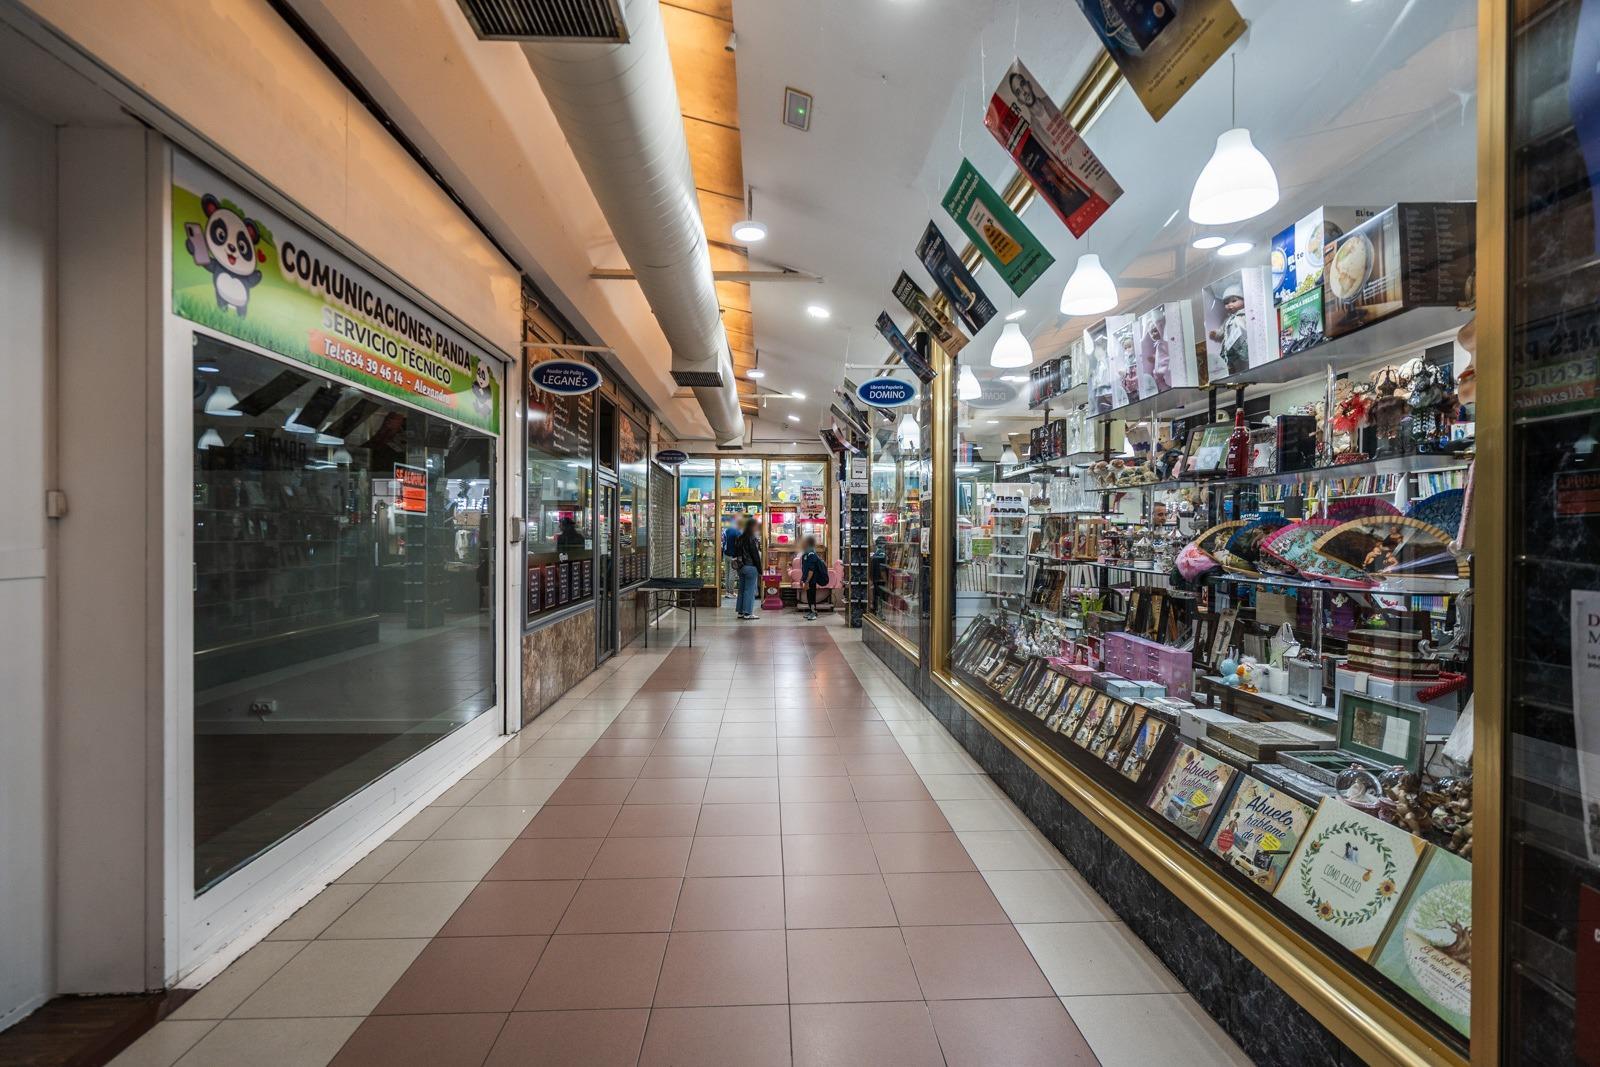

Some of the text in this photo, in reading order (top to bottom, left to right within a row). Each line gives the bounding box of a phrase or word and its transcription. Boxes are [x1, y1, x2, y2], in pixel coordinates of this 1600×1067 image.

[281, 241, 471, 371] COMUNICACIONES PANDA
[322, 307, 451, 385] SERVICIO TÉCNICO
[324, 338, 364, 369] Tel:634
[366, 358, 378, 375] 39
[380, 365, 392, 380] 46
[393, 369, 404, 385] 14
[542, 375, 588, 387] LEGANÉS
[869, 391, 906, 399] DOMINO
[1588, 613, 1600, 627] D
[1183, 760, 1220, 784] Abuela
[1246, 796, 1293, 830] Abuelo,
[1241, 829, 1255, 840] de
[1323, 864, 1362, 894] CÓMO CREZCO
